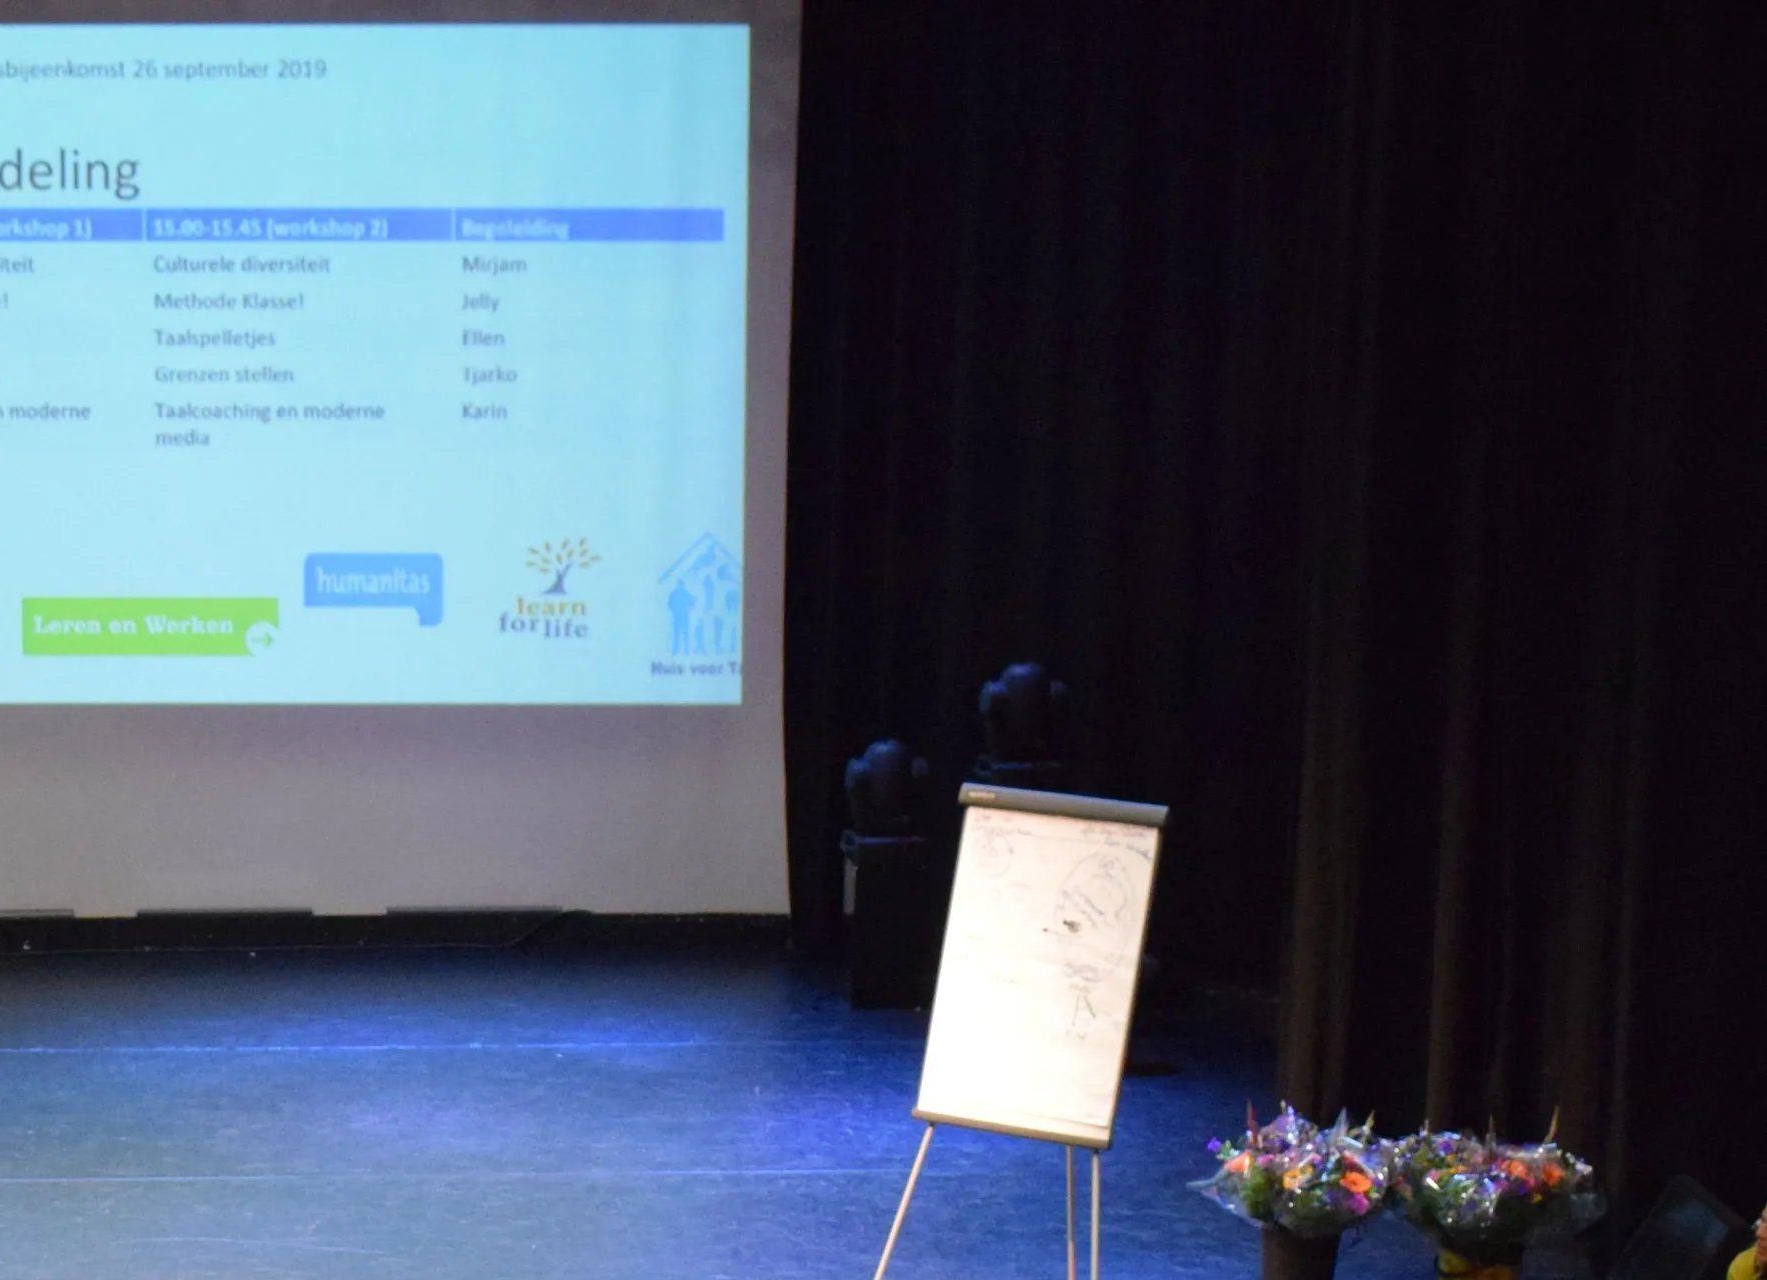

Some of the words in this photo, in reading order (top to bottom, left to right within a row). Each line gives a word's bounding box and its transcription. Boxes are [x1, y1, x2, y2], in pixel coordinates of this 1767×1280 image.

[133, 60, 158, 79] 26
[163, 60, 270, 83] september
[277, 60, 328, 79] 2019
[73, 219, 92, 239] 1)
[153, 219, 262, 237] 15.00-15.45
[267, 218, 366, 240] (workshop
[370, 219, 389, 240] 2)
[153, 255, 236, 273] Culturele
[241, 255, 331, 273] diversiteit
[462, 255, 528, 276] Mirjam
[154, 293, 236, 310] Methode
[242, 293, 305, 310] Klasse!
[462, 293, 500, 313] Jelly
[155, 329, 276, 350] Taalspelletjes
[462, 329, 505, 347] Ellen
[155, 366, 230, 384] Grenzen
[235, 366, 295, 384] stellen
[462, 366, 518, 387] Tjarko
[9, 403, 91, 420] moderne
[156, 403, 272, 424] Taalcoaching
[276, 408, 299, 420] en
[304, 403, 385, 420] moderne
[462, 403, 508, 420] Karin
[156, 430, 211, 446] media
[315, 565, 432, 594] humanitas
[516, 596, 588, 616] learn
[34, 615, 102, 635] Leren
[109, 619, 137, 635] en
[145, 615, 234, 635] Werken
[499, 611, 539, 633] for
[544, 616, 589, 640] life
